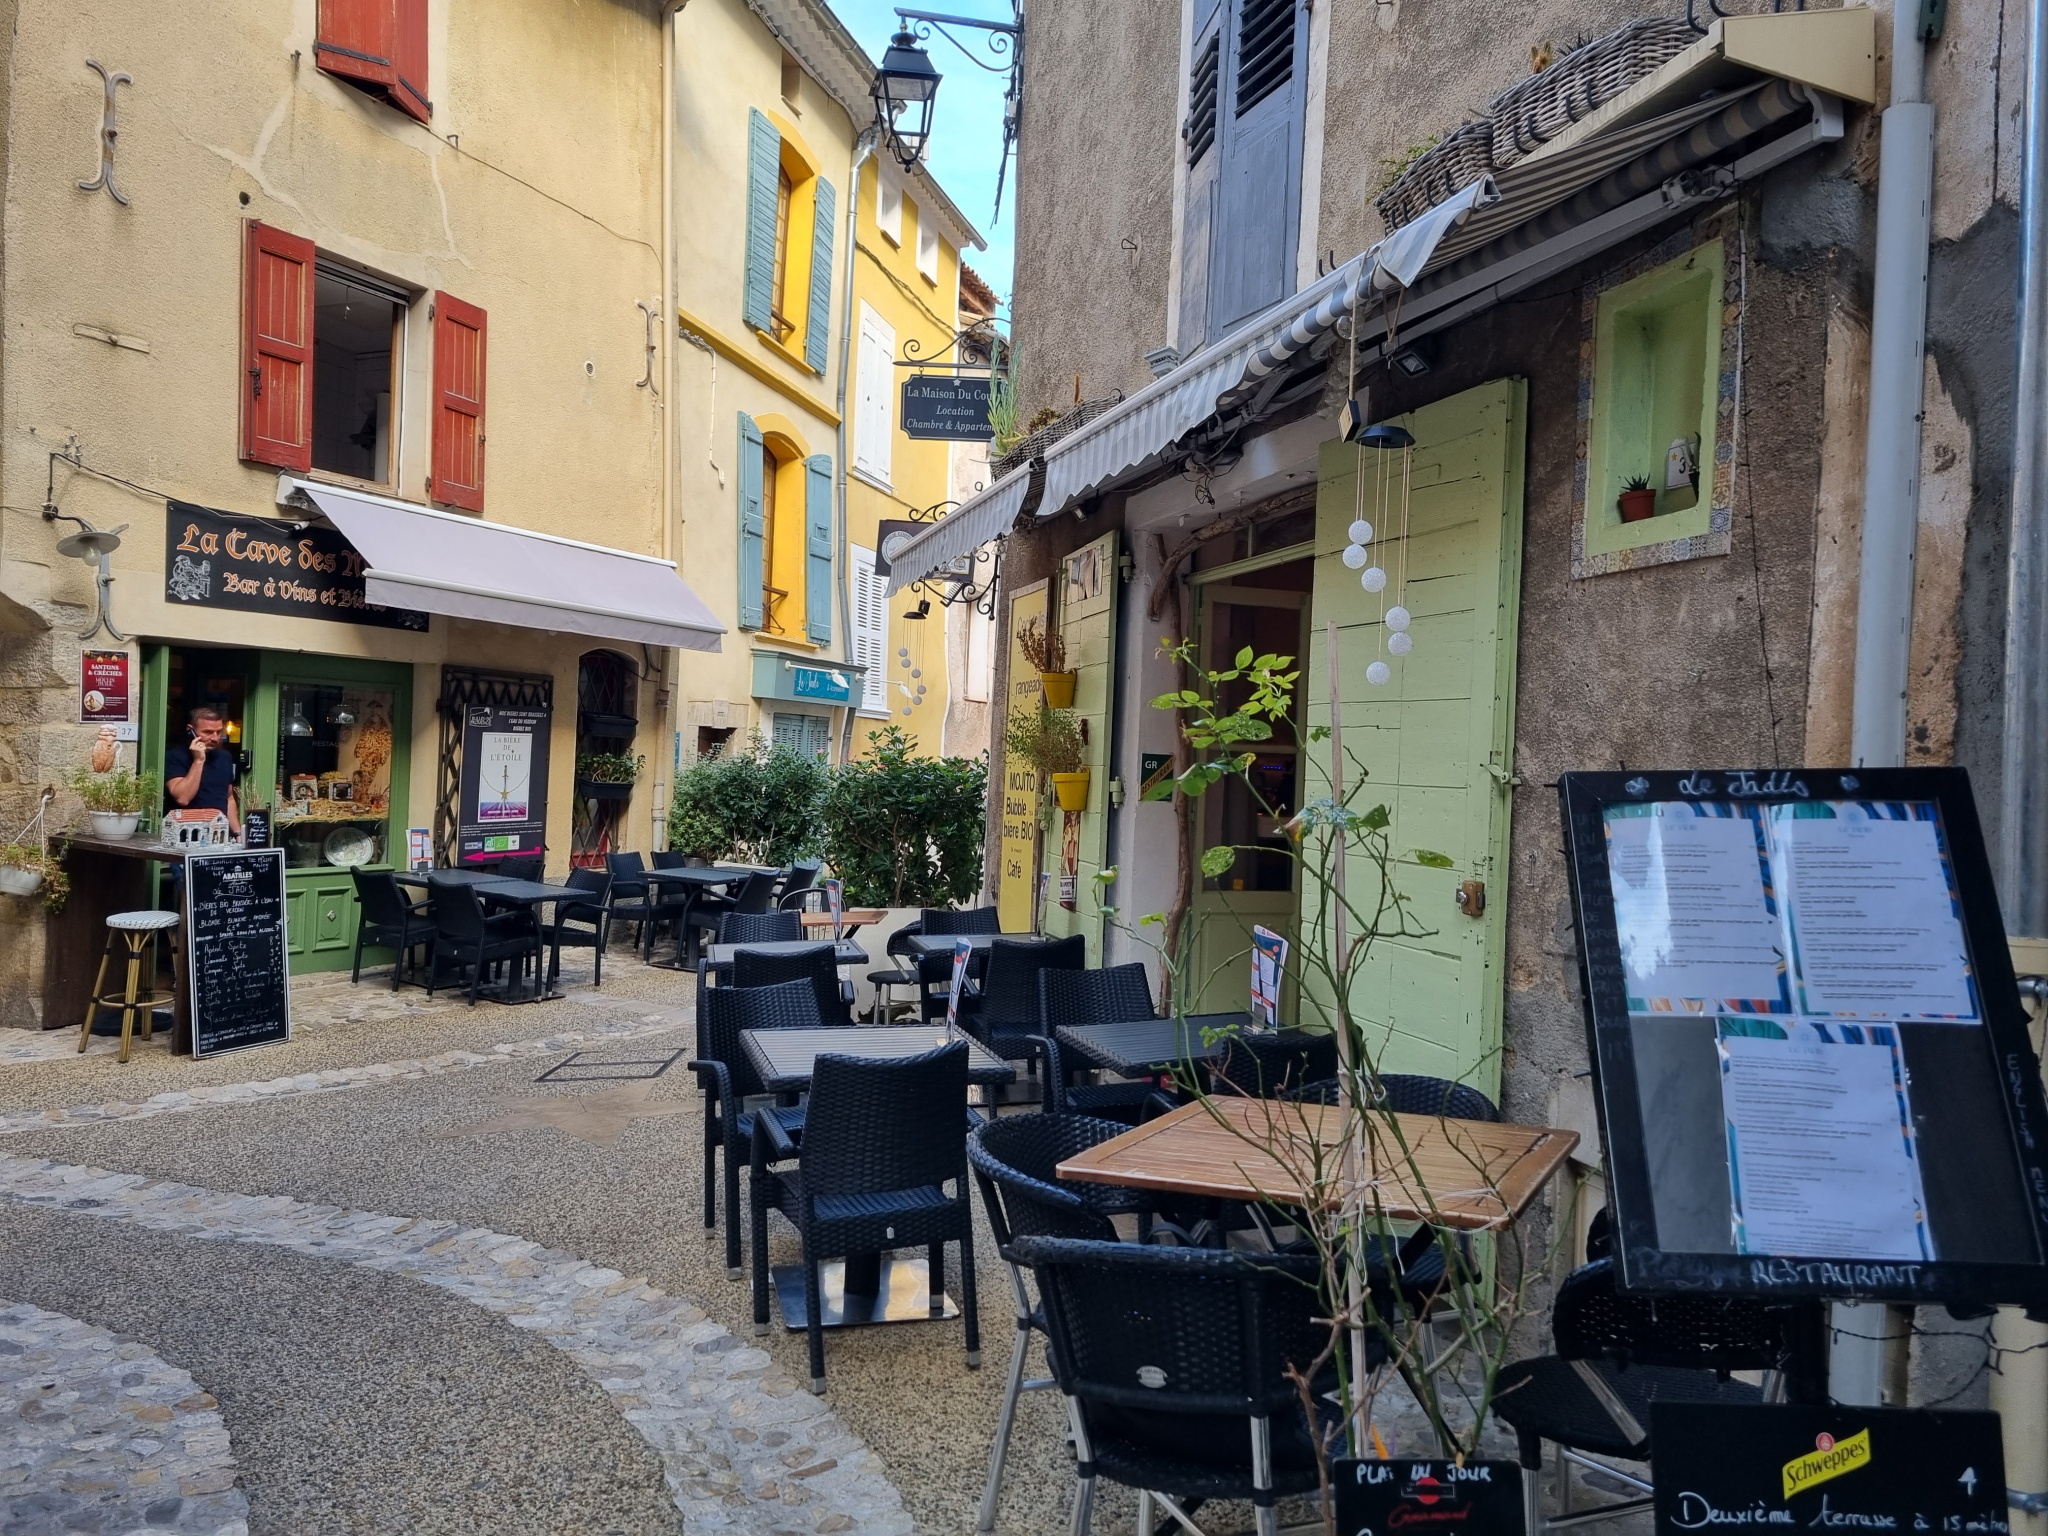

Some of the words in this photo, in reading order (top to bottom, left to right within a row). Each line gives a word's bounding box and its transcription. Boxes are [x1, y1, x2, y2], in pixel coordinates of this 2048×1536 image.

[907, 386, 919, 397] La
[921, 387, 955, 399] Maison
[958, 388, 971, 399] Du
[974, 389, 995, 400] Cou
[936, 405, 975, 416] Location
[906, 418, 944, 430] Chambre
[946, 421, 952, 430] &
[954, 421, 995, 433] Appartem
[176, 523, 219, 555] La
[225, 527, 292, 566] Cave
[298, 539, 337, 573] des
[223, 572, 260, 596] Bar
[263, 577, 276, 597] à
[280, 580, 317, 603] Vins
[320, 587, 337, 606] et
[121, 728, 132, 736] 37
[503, 734, 521, 744] BIÈRE
[490, 753, 523, 762] L'ÉTOILE
[1145, 760, 1158, 769] GR
[1010, 770, 1035, 792] MOJITO
[1006, 797, 1027, 817] Bubble
[1004, 821, 1019, 840] bière
[1020, 821, 1034, 842] BIO
[222, 871, 253, 880] ABATILLES
[1007, 859, 1022, 879] Café
[1750, 1258, 1922, 1287] RESTAURANT
[1786, 1440, 1867, 1491] Schweppes
[1669, 1490, 1796, 1529] Deuxième
[1808, 1493, 1898, 1529] terrasse
[1913, 1513, 1929, 1530] à
[1944, 1515, 1960, 1532] 15
